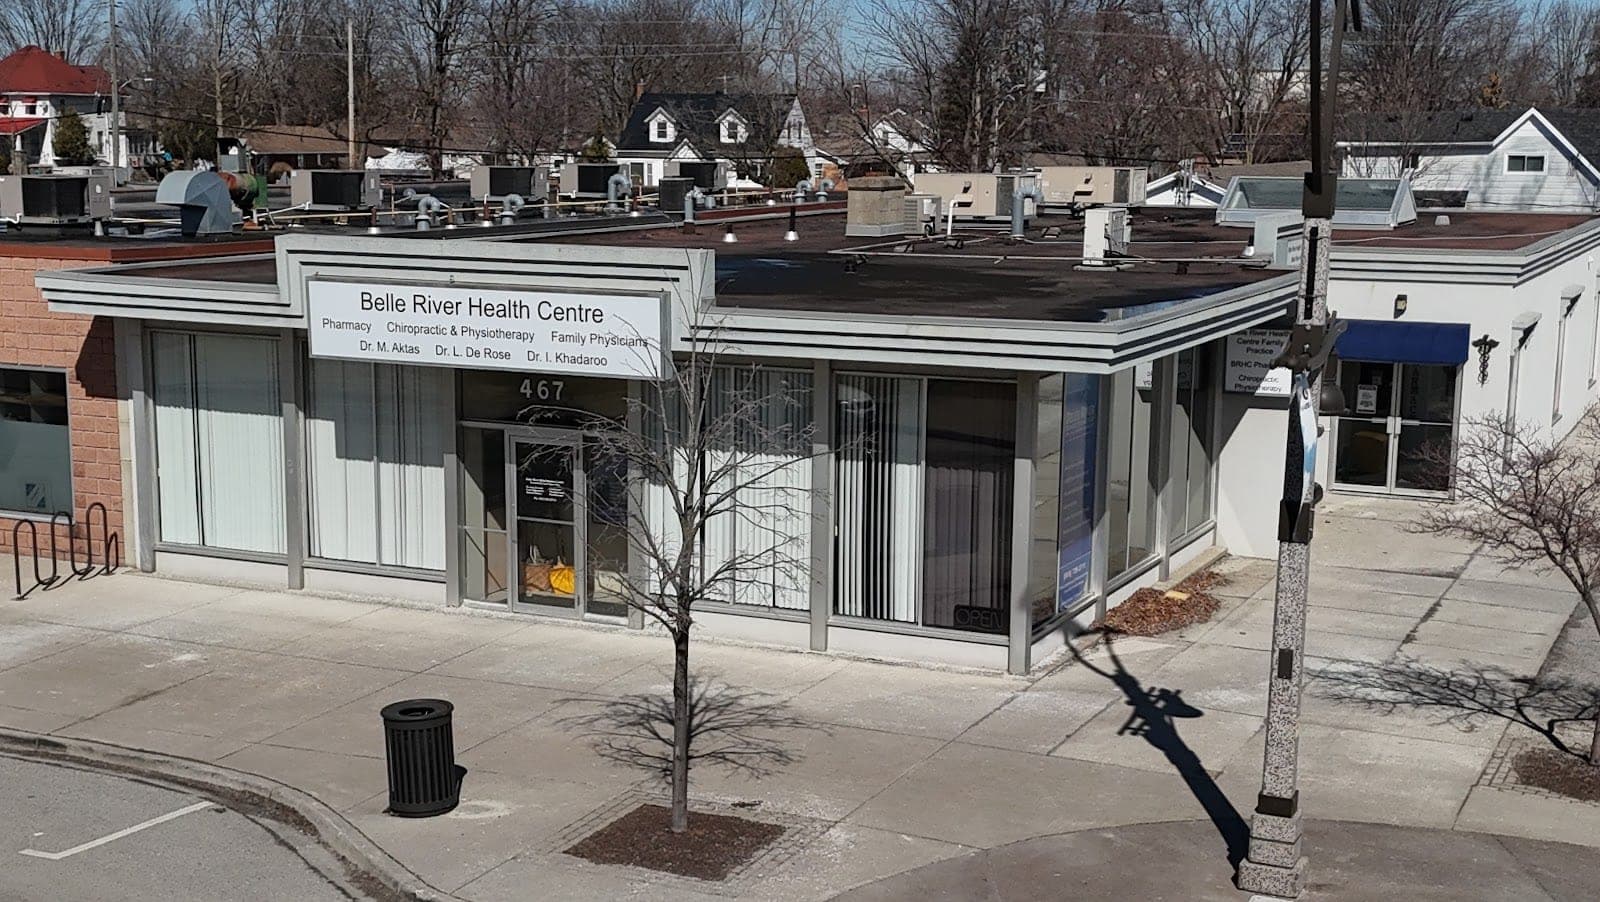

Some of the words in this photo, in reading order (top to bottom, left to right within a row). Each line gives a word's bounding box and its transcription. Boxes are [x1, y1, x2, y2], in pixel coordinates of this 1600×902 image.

[361, 291, 406, 312] Belle
[413, 294, 462, 315] River
[469, 297, 530, 319] Health
[537, 300, 604, 323] Centre
[322, 317, 372, 333] Pharmacy
[386, 321, 448, 337] Chiropractic
[450, 325, 458, 336] &
[461, 325, 535, 342] Physiotherapy
[551, 331, 586, 346] Family
[590, 333, 649, 348] Physicians
[360, 340, 374, 352] Dr.
[377, 341, 389, 353] M.
[391, 342, 420, 354] Aktas
[435, 344, 450, 357] Dr.
[453, 346, 463, 357] L.
[466, 346, 480, 358] De
[483, 348, 511, 360] Rose
[527, 350, 542, 363] Dr.
[546, 351, 552, 363] I.
[555, 352, 608, 366] Khadaroo
[520, 378, 564, 401] 467
[955, 609, 1004, 628] OPEN
